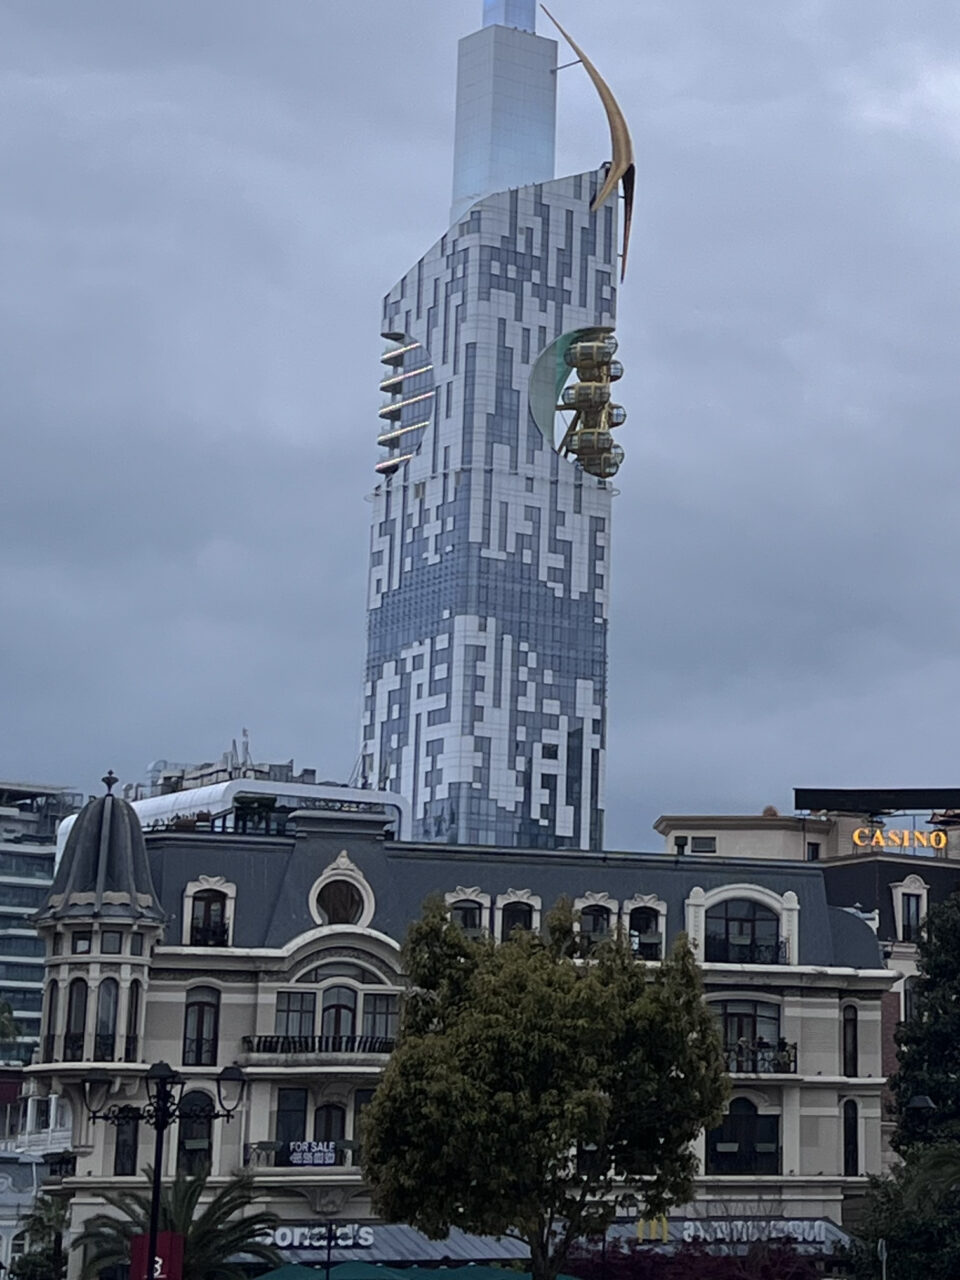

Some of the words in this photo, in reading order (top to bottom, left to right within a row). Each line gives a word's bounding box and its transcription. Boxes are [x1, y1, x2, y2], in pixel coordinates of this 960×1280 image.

[852, 827, 948, 849] CASINO
[290, 1141, 309, 1152] FOR
[310, 1141, 336, 1152] SALE
